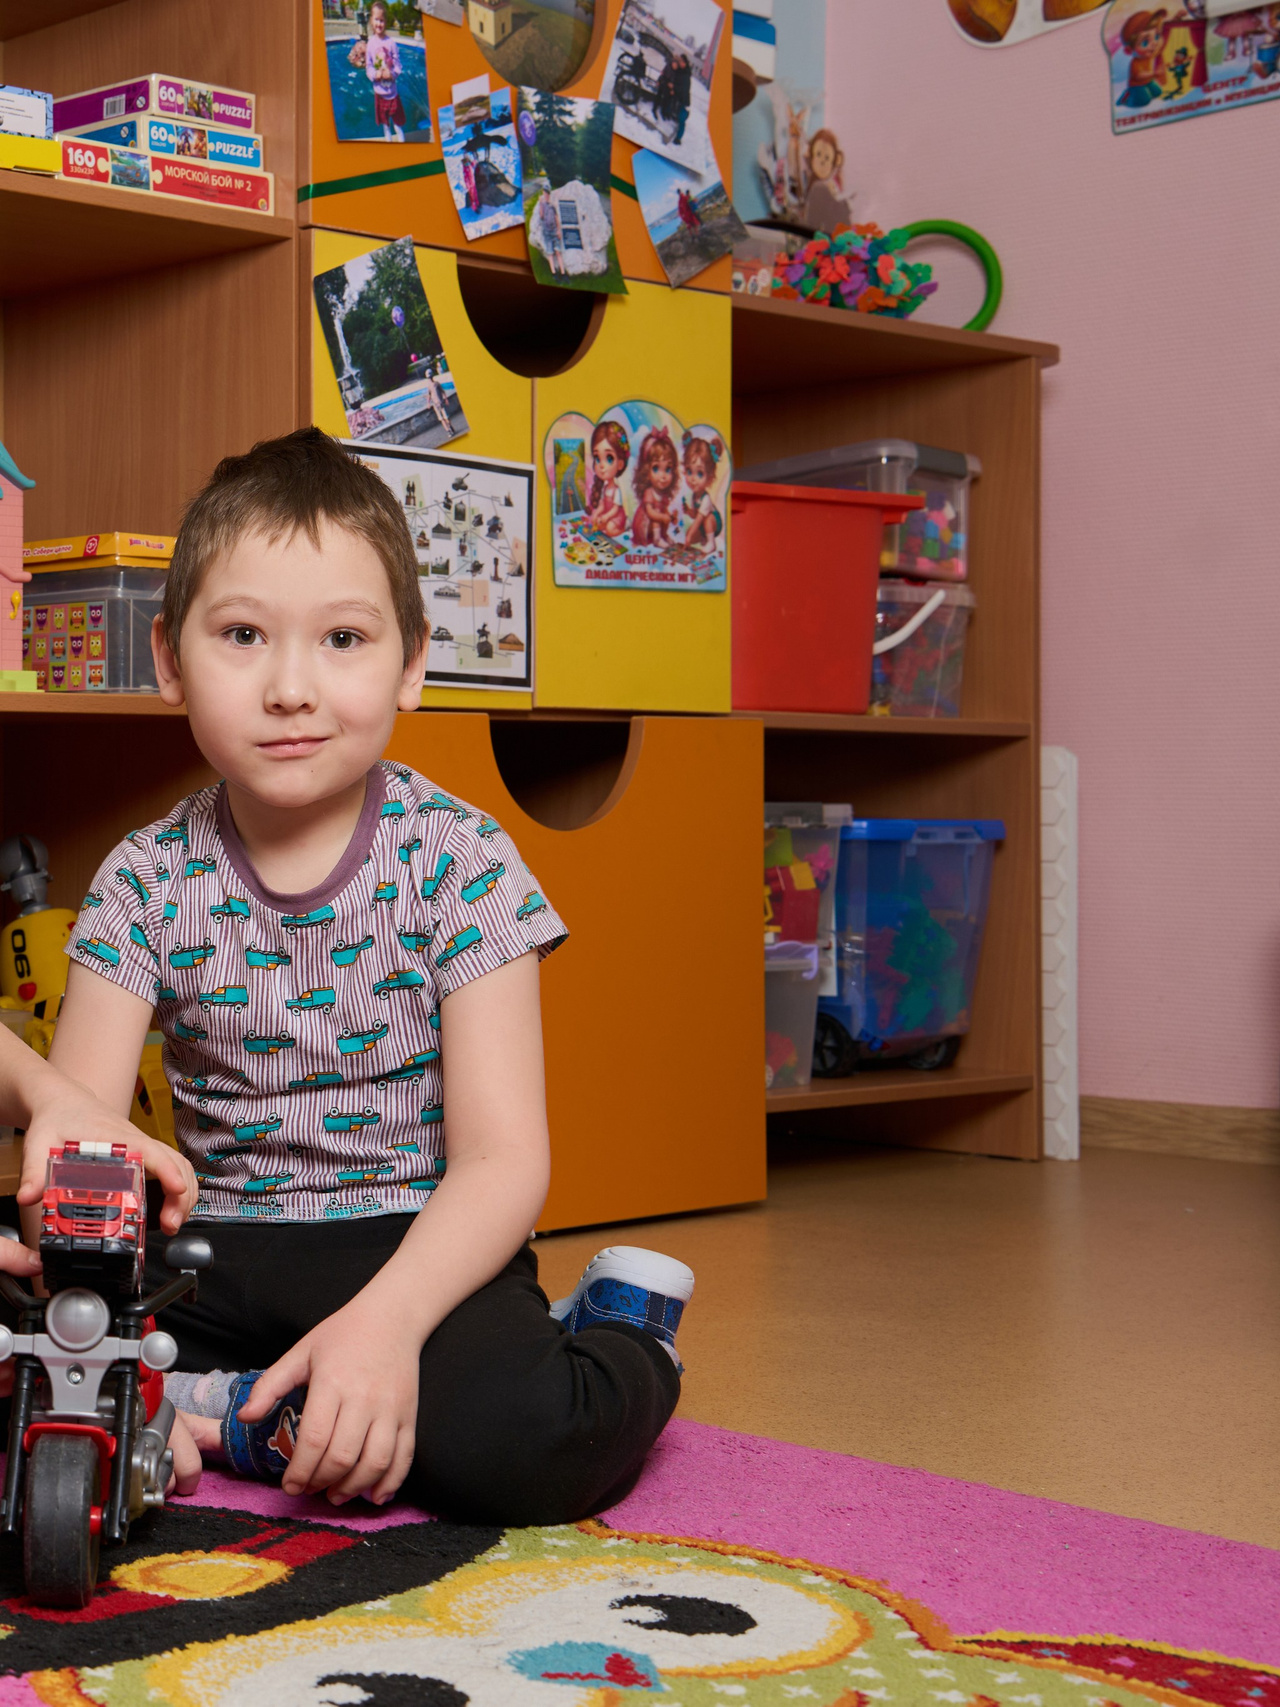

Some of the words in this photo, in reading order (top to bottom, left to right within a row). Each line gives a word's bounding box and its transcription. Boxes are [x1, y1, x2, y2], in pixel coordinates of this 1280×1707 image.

[1201, 76, 1248, 94] ЦЕНТР
[160, 86, 176, 102] 60
[220, 103, 252, 120] PUZZLE
[150, 126, 167, 142] 60
[68, 147, 96, 168] 160
[216, 142, 254, 158] PUZZLE
[164, 165, 210, 184] МОРСКОЙ
[211, 174, 232, 188] БОЙ
[234, 179, 244, 190] №
[246, 181, 252, 192] 2
[624, 554, 658, 565] ЦЕНТР
[585, 568, 676, 582] ДИДАКТИЧЕСКИХ
[678, 573, 696, 583] ИГР
